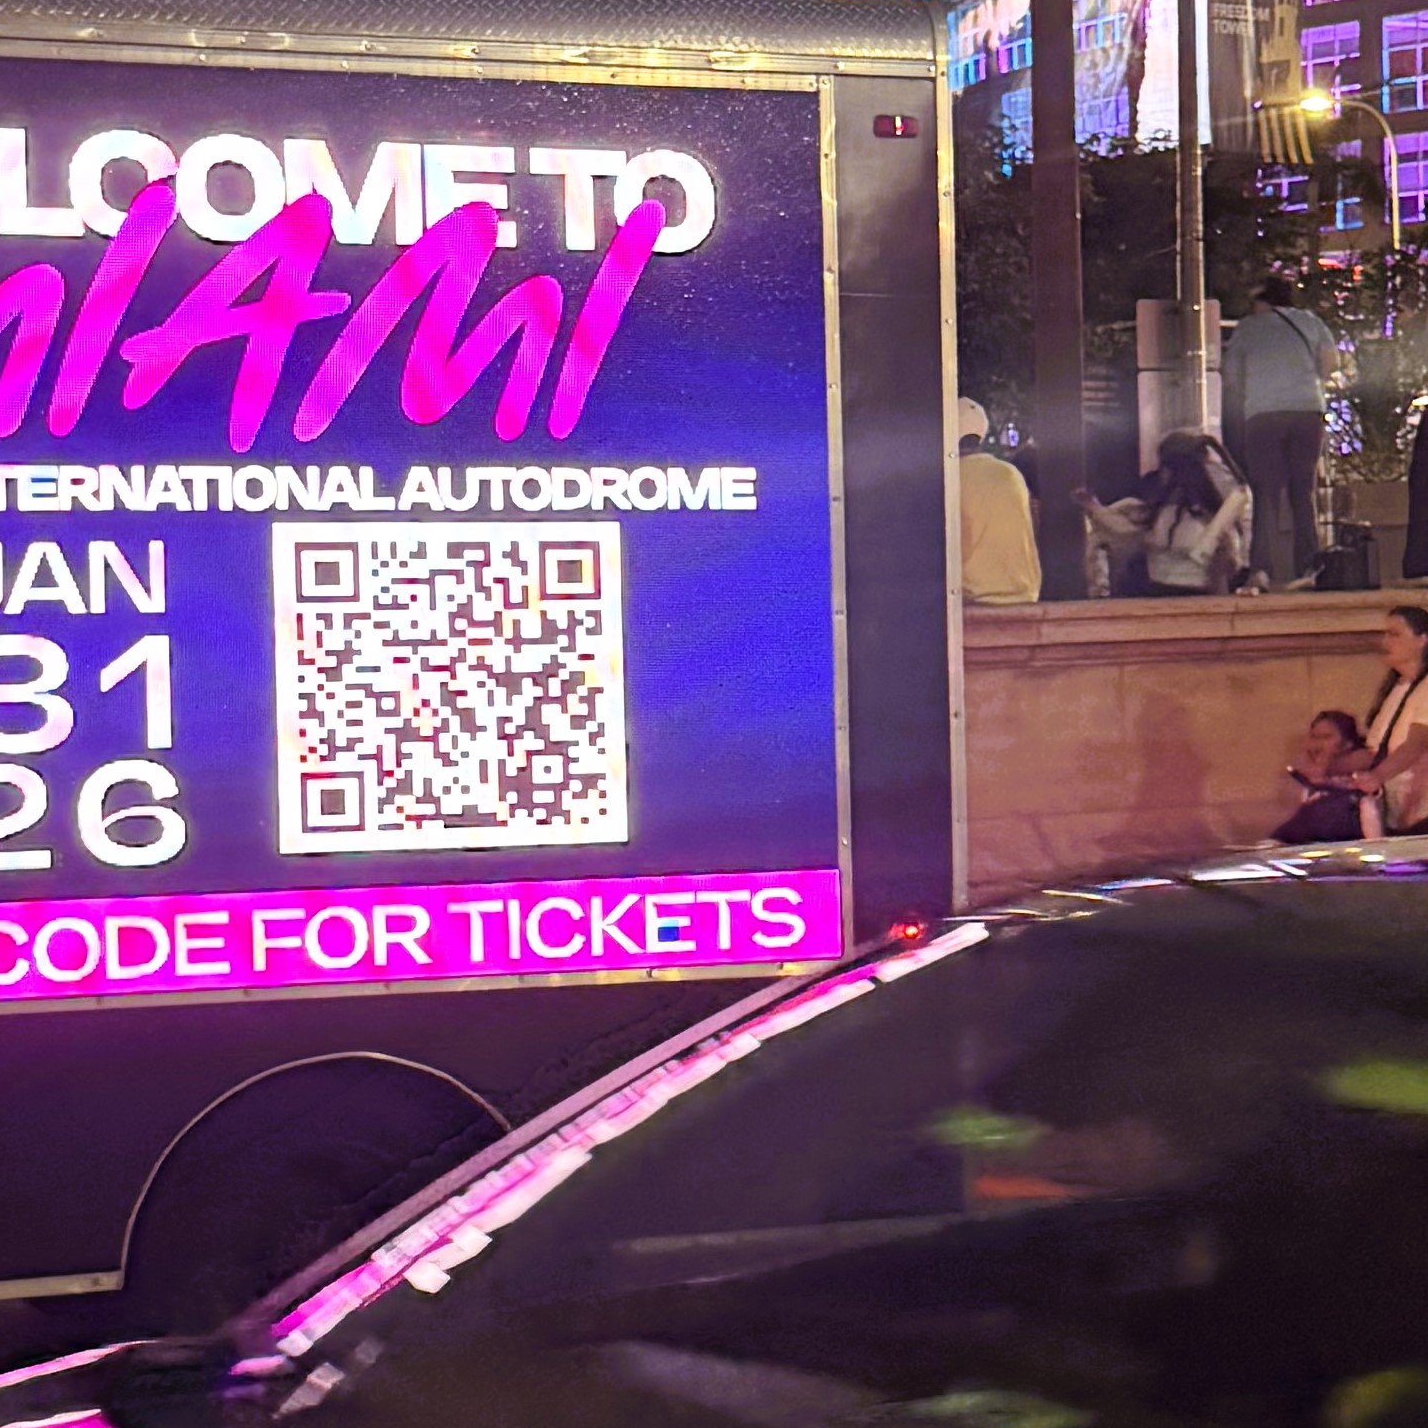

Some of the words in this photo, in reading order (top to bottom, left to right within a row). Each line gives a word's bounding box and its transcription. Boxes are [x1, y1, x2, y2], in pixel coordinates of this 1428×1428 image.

[1213, 2, 1270, 21] FREEOM
[1213, 18, 1255, 35] TOWE
[529, 146, 717, 254] TO
[398, 465, 758, 511] AUTODROME
[252, 904, 432, 971] FOR
[446, 886, 807, 962] TICKETS
